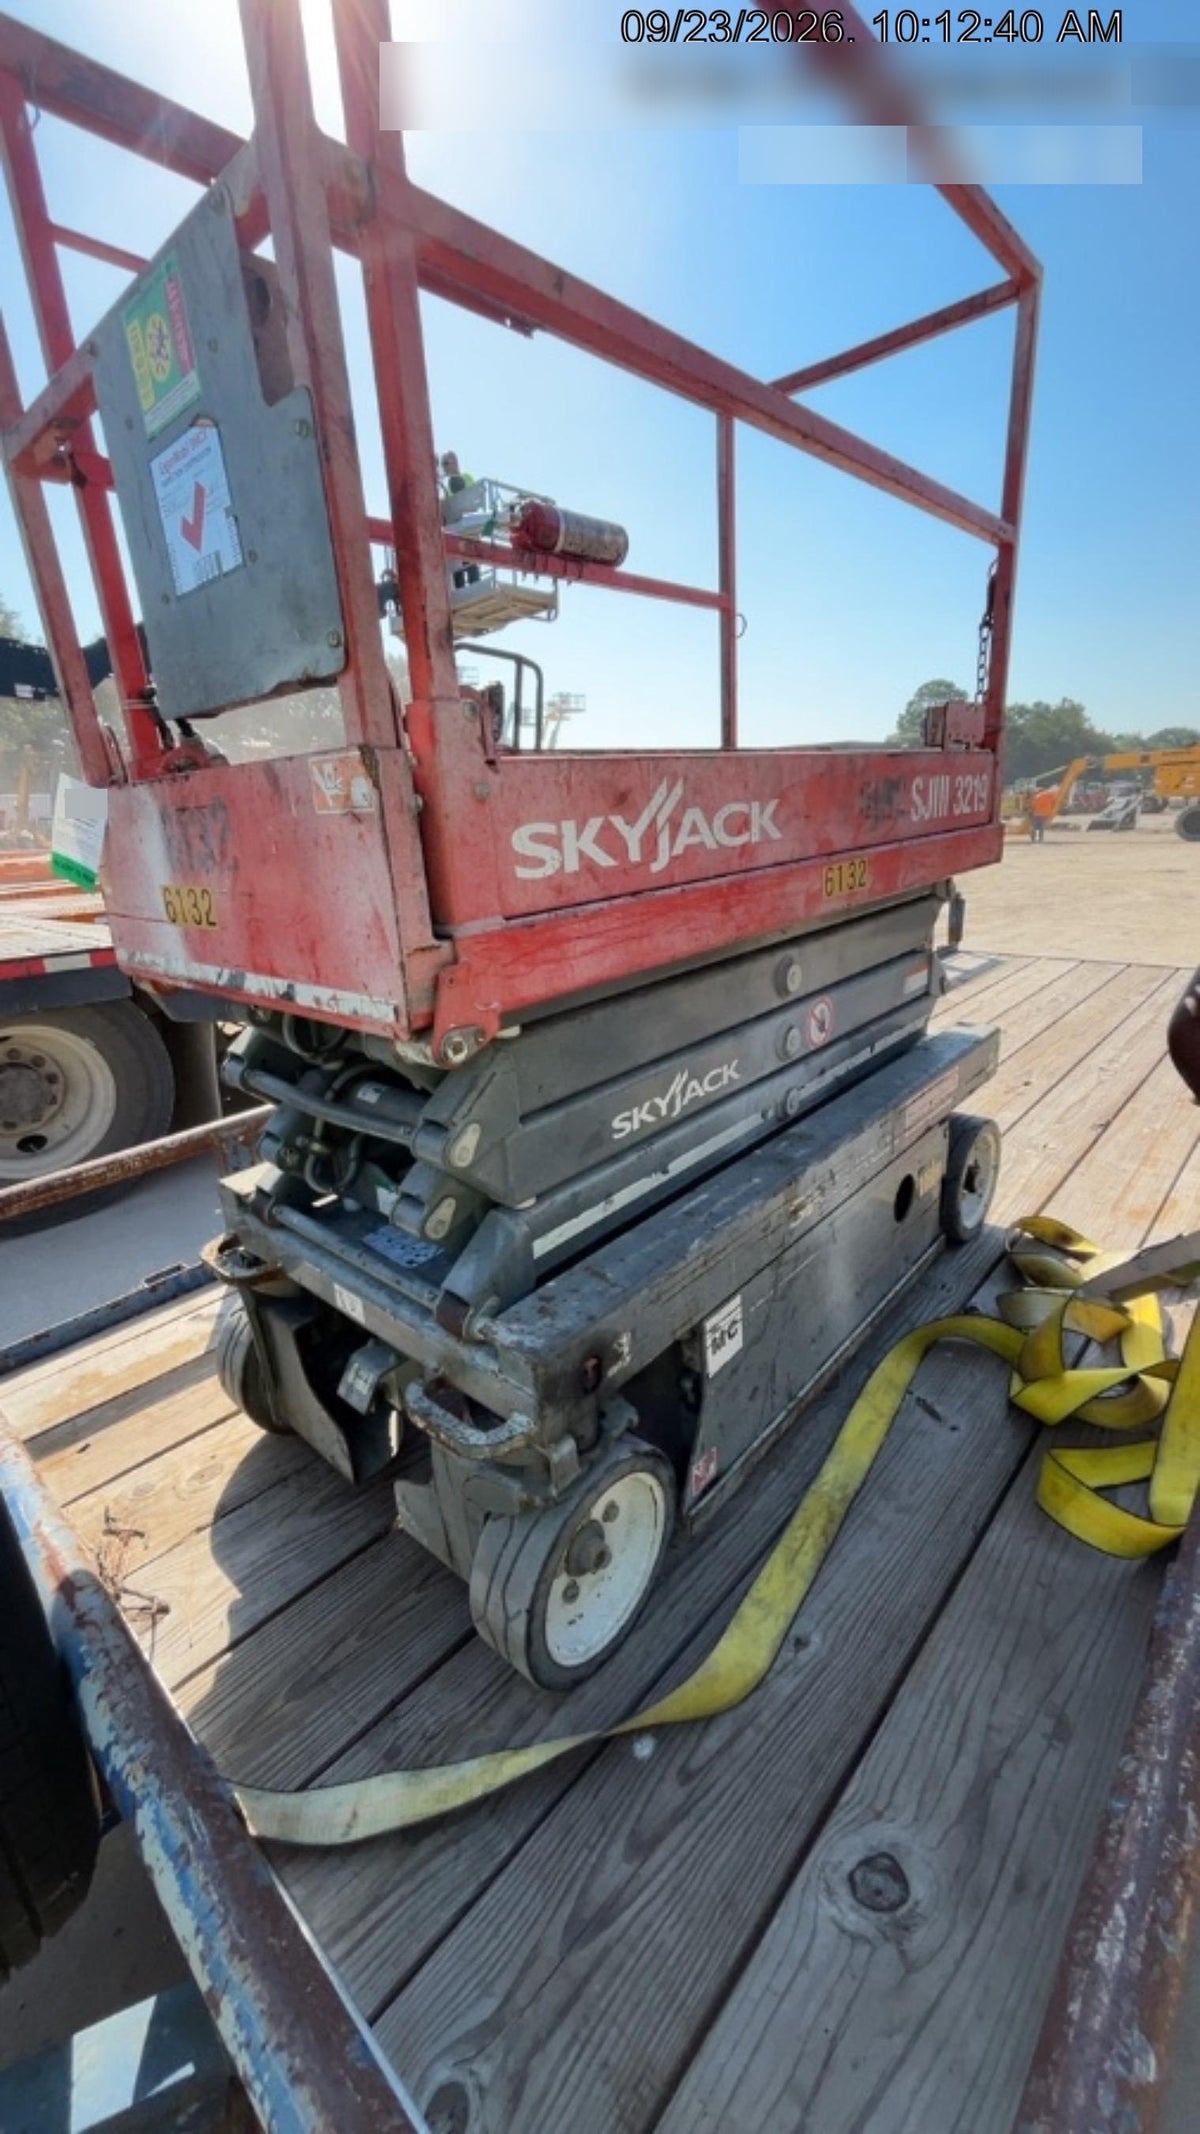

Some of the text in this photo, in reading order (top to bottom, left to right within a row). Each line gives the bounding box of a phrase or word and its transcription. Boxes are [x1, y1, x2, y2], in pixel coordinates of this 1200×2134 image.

[953, 774, 988, 816] 3219
[511, 776, 783, 880] SKYJACK
[825, 861, 867, 897] 6132
[162, 886, 218, 927] 6132
[611, 1060, 741, 1139] SKYJACK
